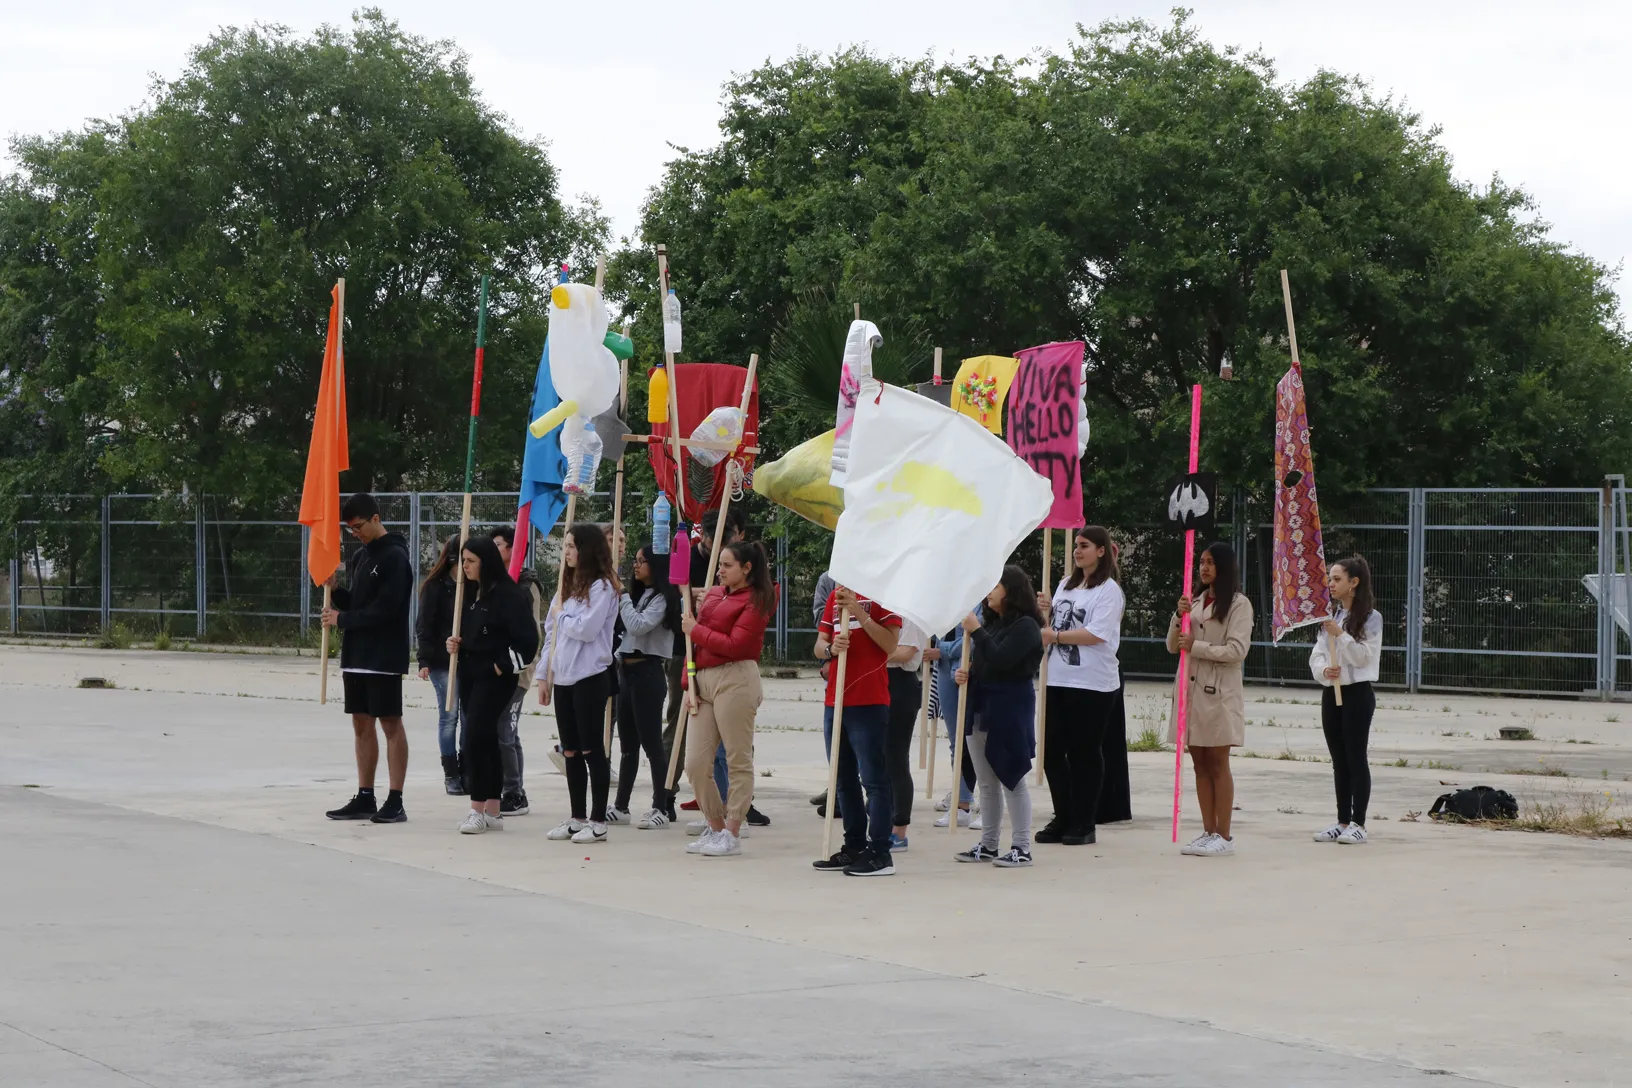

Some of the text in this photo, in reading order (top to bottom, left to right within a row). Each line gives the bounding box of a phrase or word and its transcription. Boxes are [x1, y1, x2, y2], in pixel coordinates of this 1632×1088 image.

[1018, 355, 1076, 402] VIVA
[1011, 401, 1075, 449] HELLO
[1024, 452, 1077, 499] TTY
